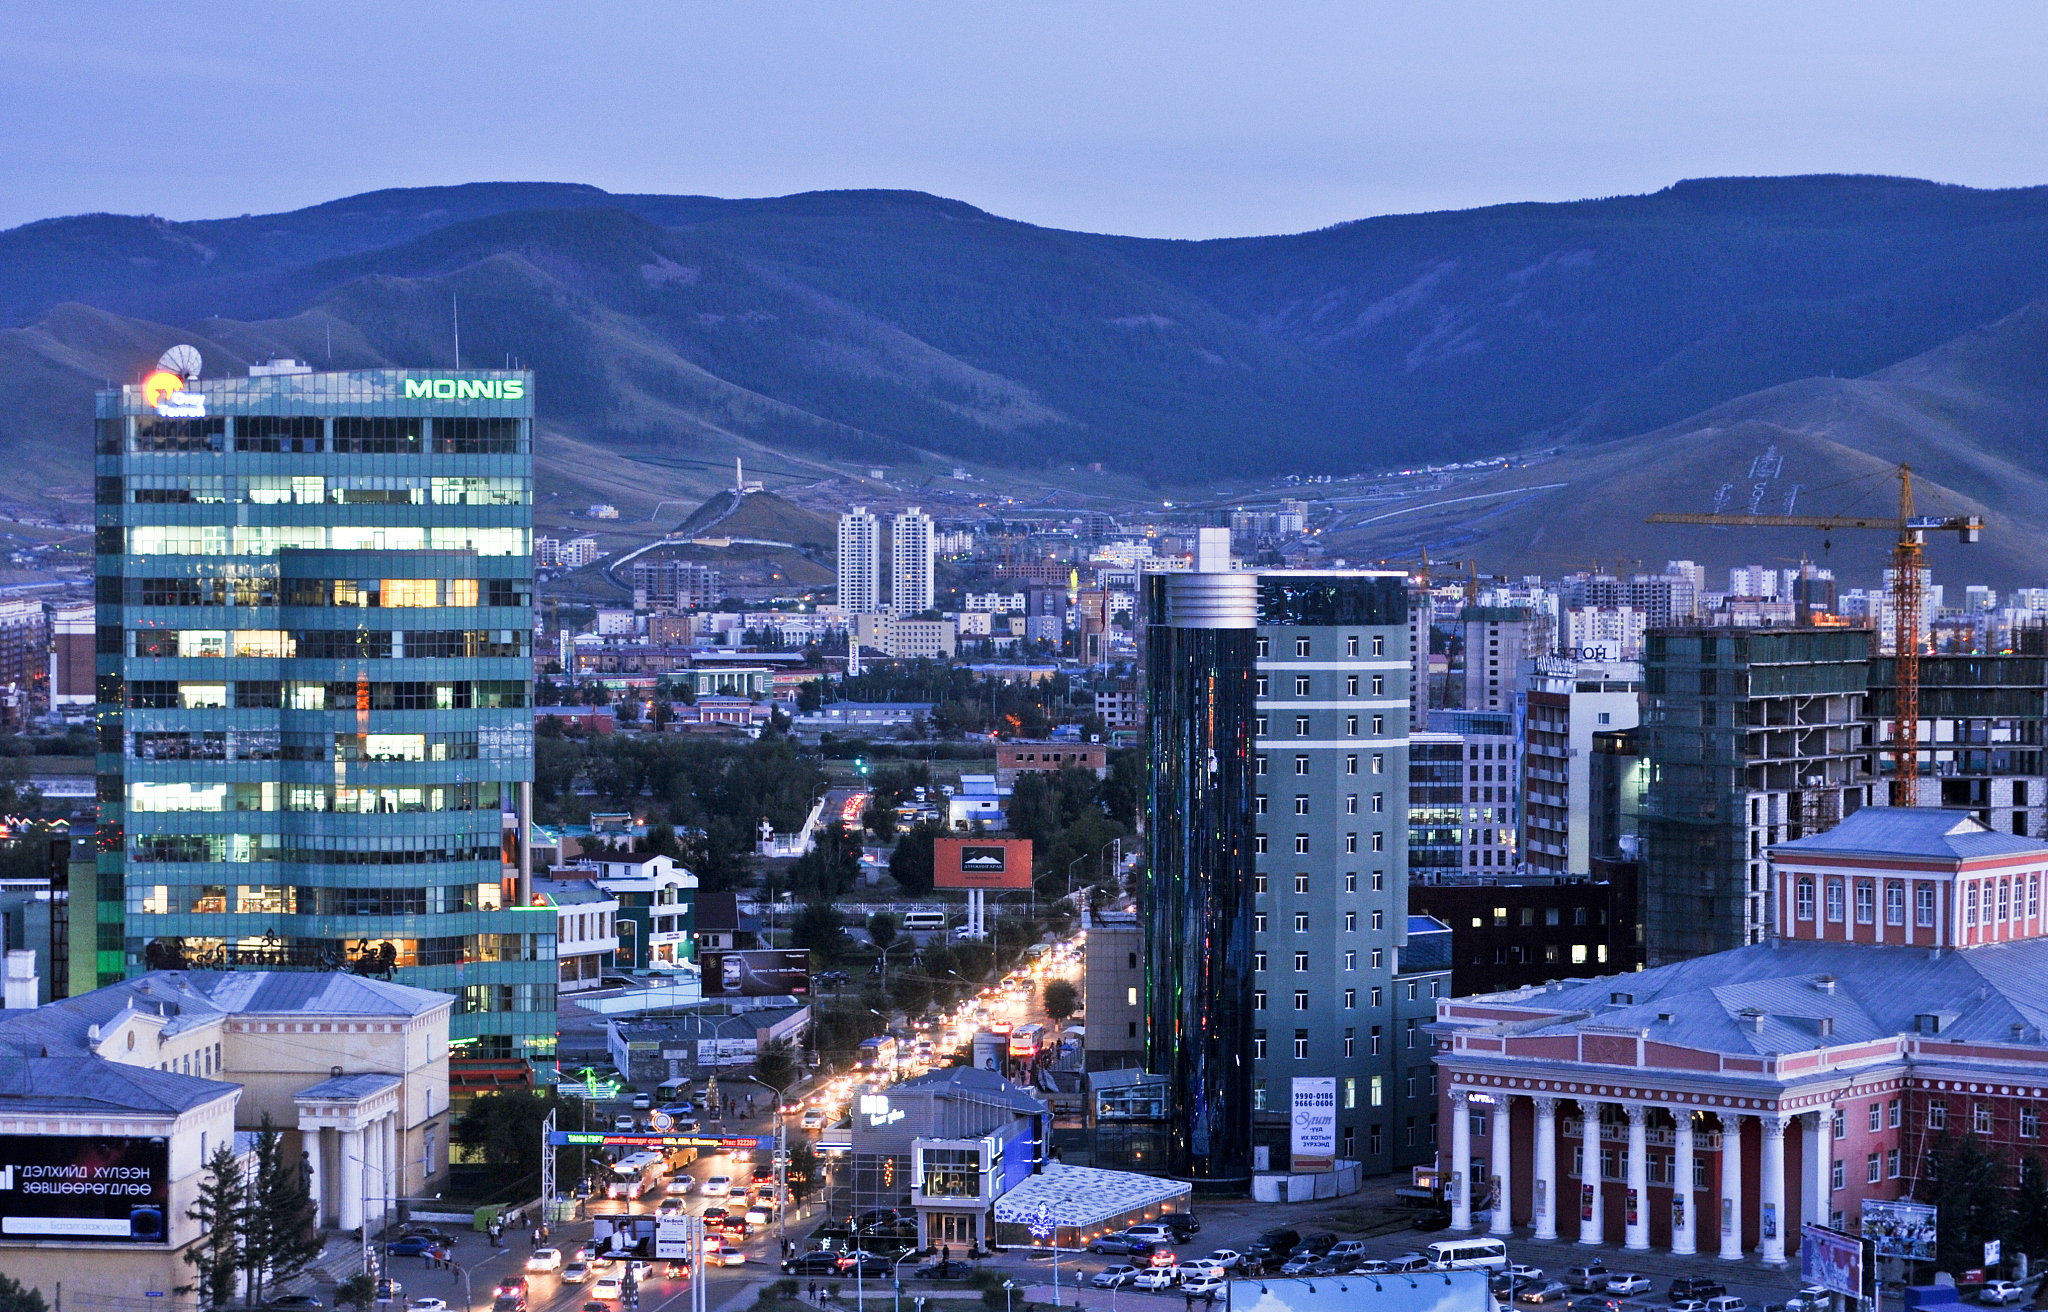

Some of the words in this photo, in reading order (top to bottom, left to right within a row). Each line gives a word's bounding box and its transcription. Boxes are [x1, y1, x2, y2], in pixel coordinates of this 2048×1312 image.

[405, 379, 524, 400] MONNIS
[861, 1095, 889, 1114] MB
[568, 1135, 587, 1143] ТАНЫ
[588, 1135, 604, 1143] ГЭРТ
[22, 1164, 87, 1178] ДЭЛХИЙД
[94, 1166, 150, 1179] ХҮЛЭЭН
[22, 1182, 152, 1195] ЗӨВШӨӨРӨГДЛӨӨ
